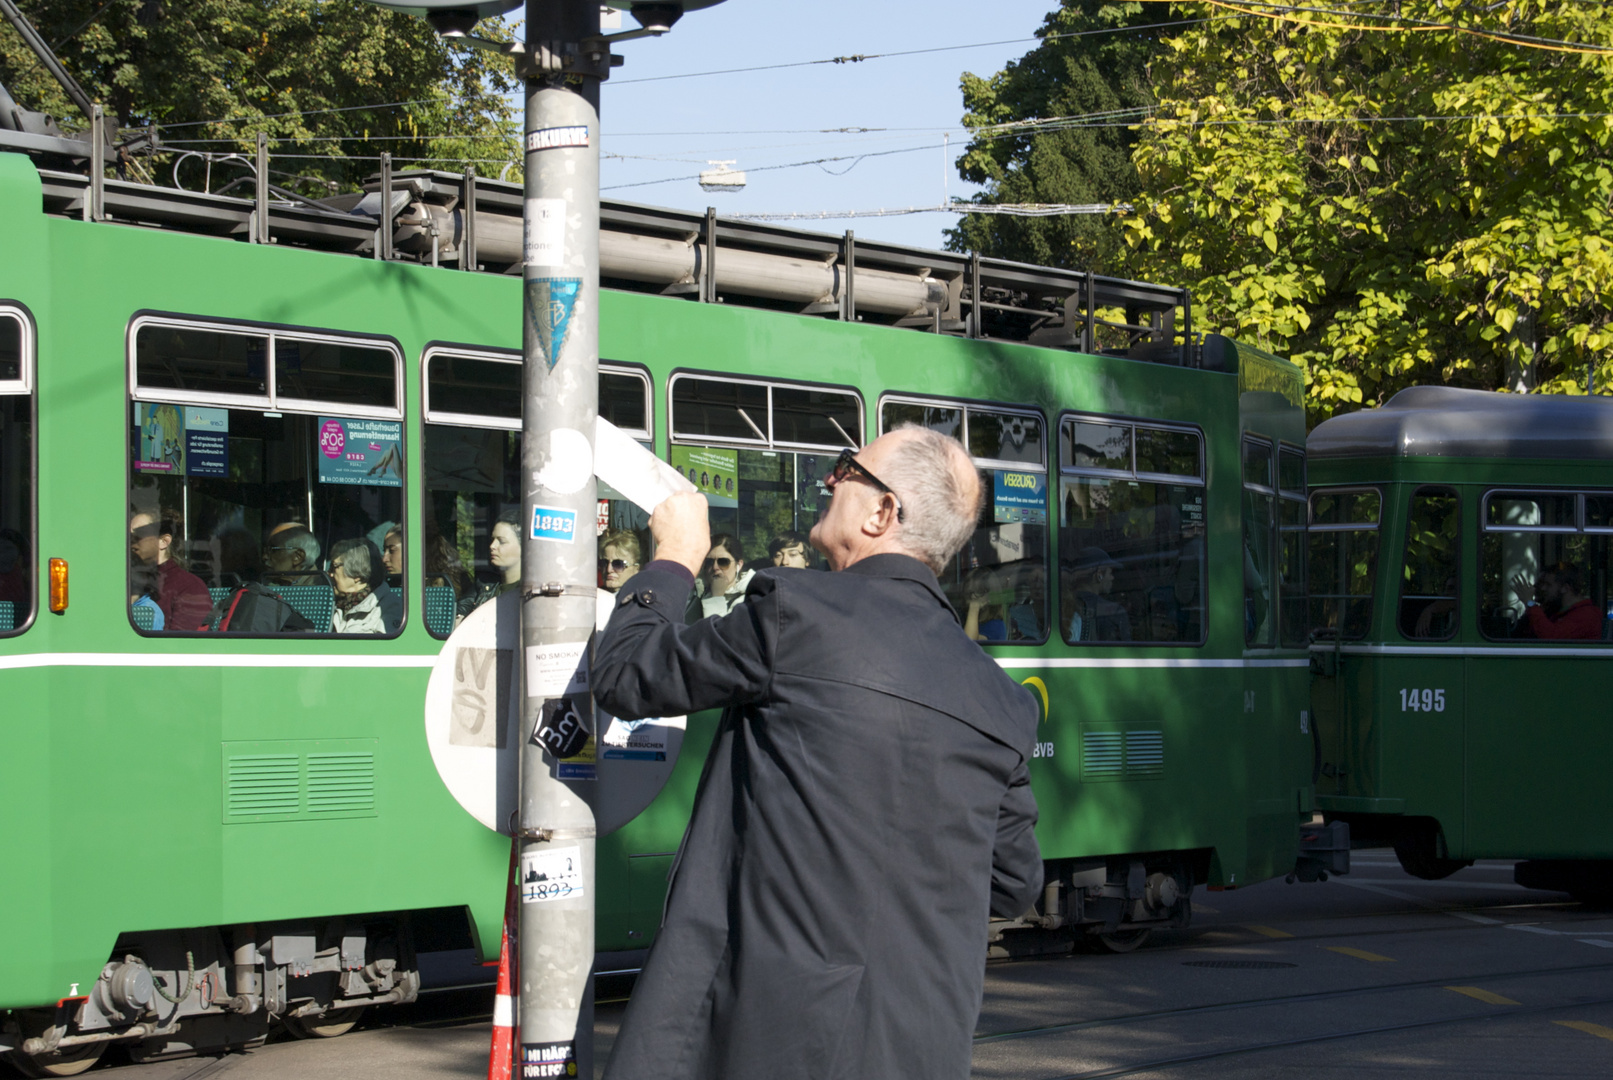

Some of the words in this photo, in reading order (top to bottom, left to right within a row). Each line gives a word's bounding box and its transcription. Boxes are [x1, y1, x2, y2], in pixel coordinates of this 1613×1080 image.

[527, 127, 587, 151] ERKURVE
[535, 514, 573, 533] 1893
[1399, 688, 1445, 712] 1495
[1033, 742, 1054, 758] BVB
[528, 882, 573, 901] 1893
[527, 1048, 541, 1062] MI
[524, 1064, 540, 1078] FÜR
